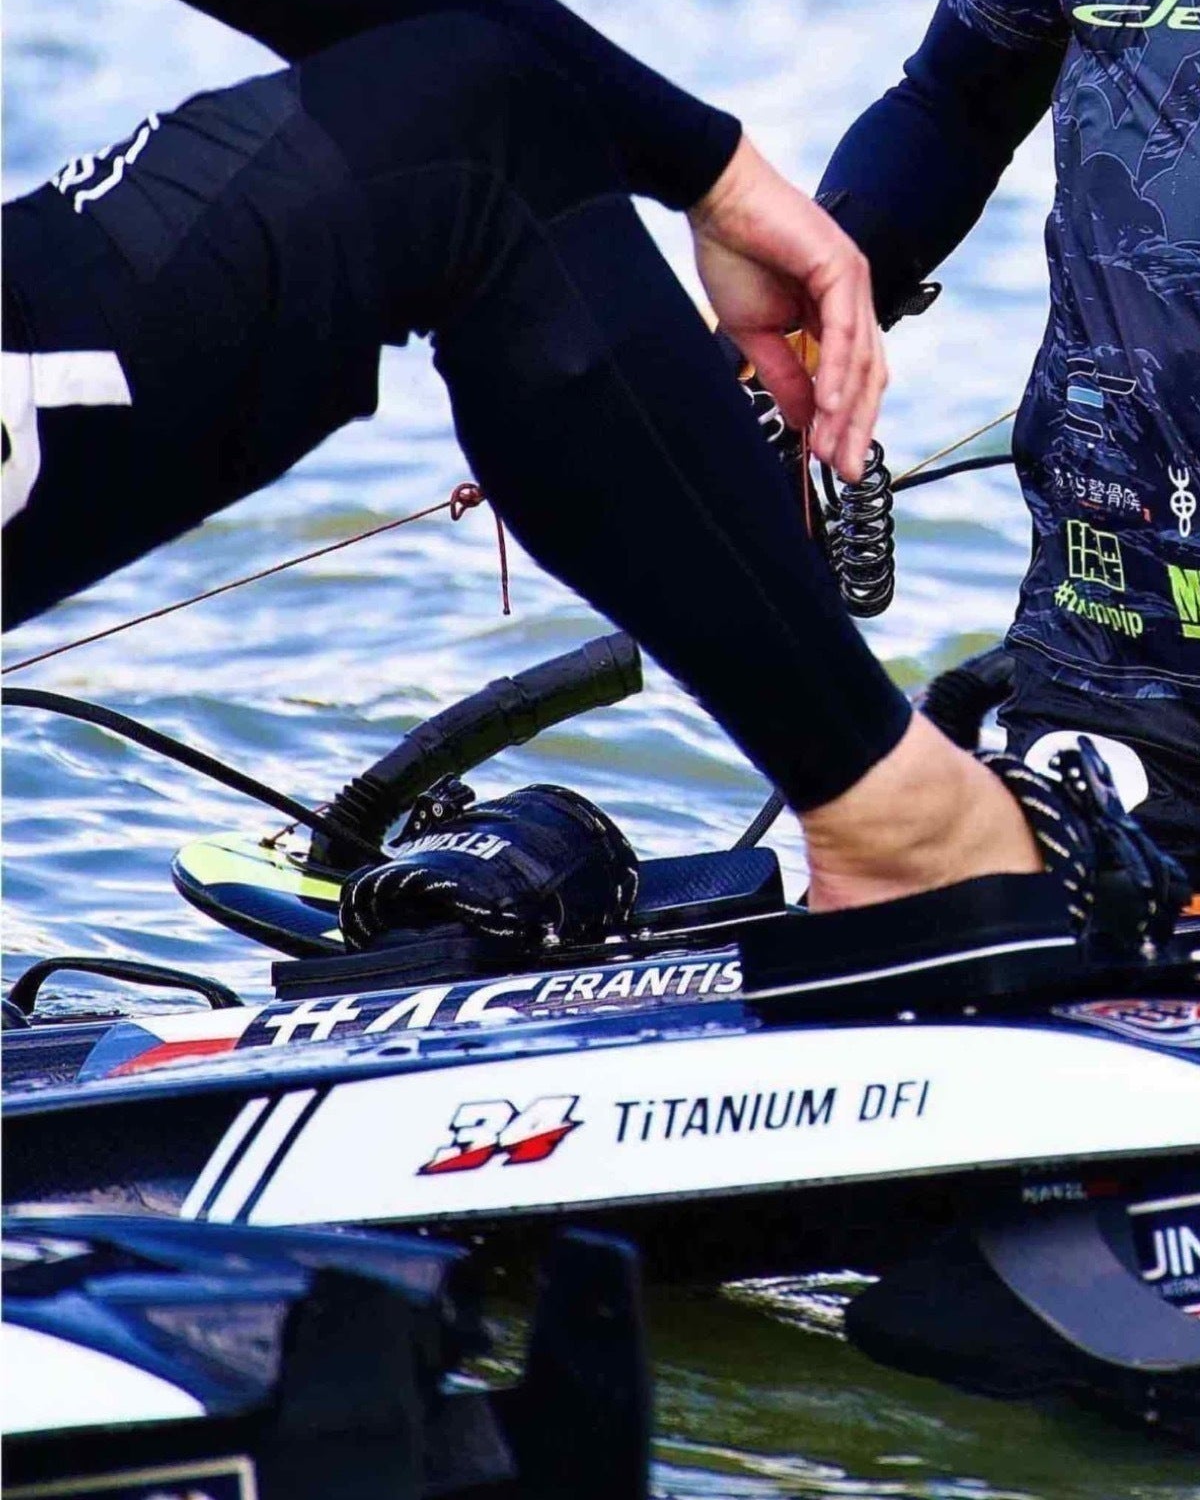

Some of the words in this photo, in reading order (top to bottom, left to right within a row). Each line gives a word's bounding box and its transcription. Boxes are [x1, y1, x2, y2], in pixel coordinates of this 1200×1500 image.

[417, 1095, 584, 1177] 34
[614, 1087, 838, 1143] TiTANIUM
[858, 1080, 929, 1122] DFI
